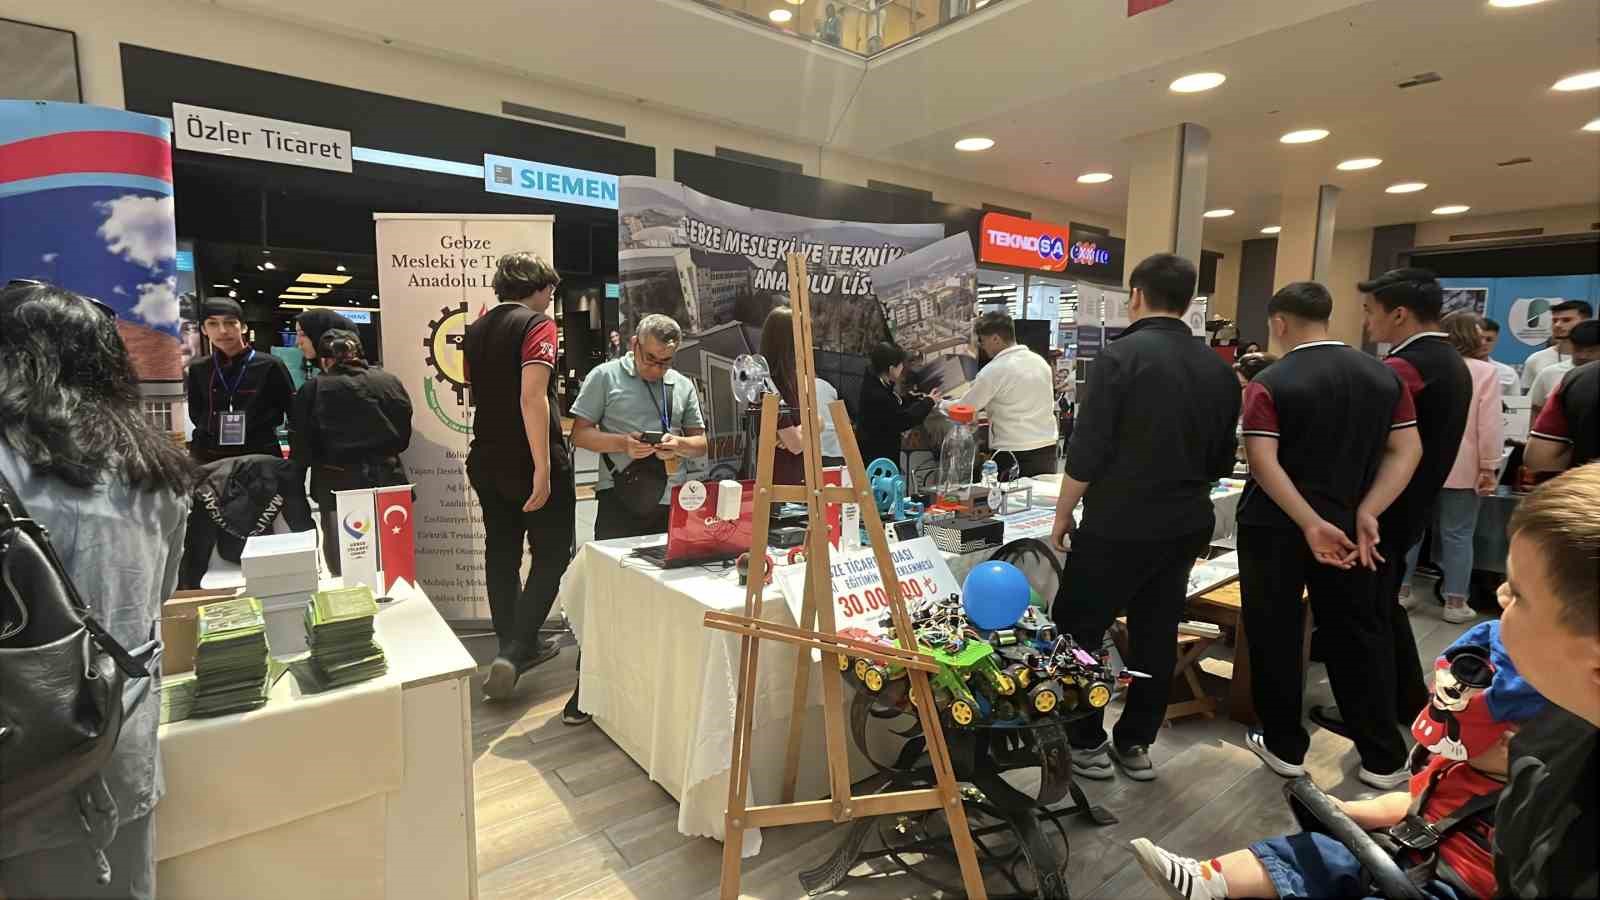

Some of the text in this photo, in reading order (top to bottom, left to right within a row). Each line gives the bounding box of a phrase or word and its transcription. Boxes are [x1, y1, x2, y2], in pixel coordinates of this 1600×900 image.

[187, 113, 342, 161] Özler Ticaret
[520, 168, 616, 201] SIEMEN
[440, 235, 491, 250] Gebze
[392, 254, 454, 269] Mesleki
[460, 257, 478, 269] ve
[408, 273, 476, 288] Anadolu
[754, 268, 875, 296] ANALU LİS
[844, 556, 877, 575] TİCAR
